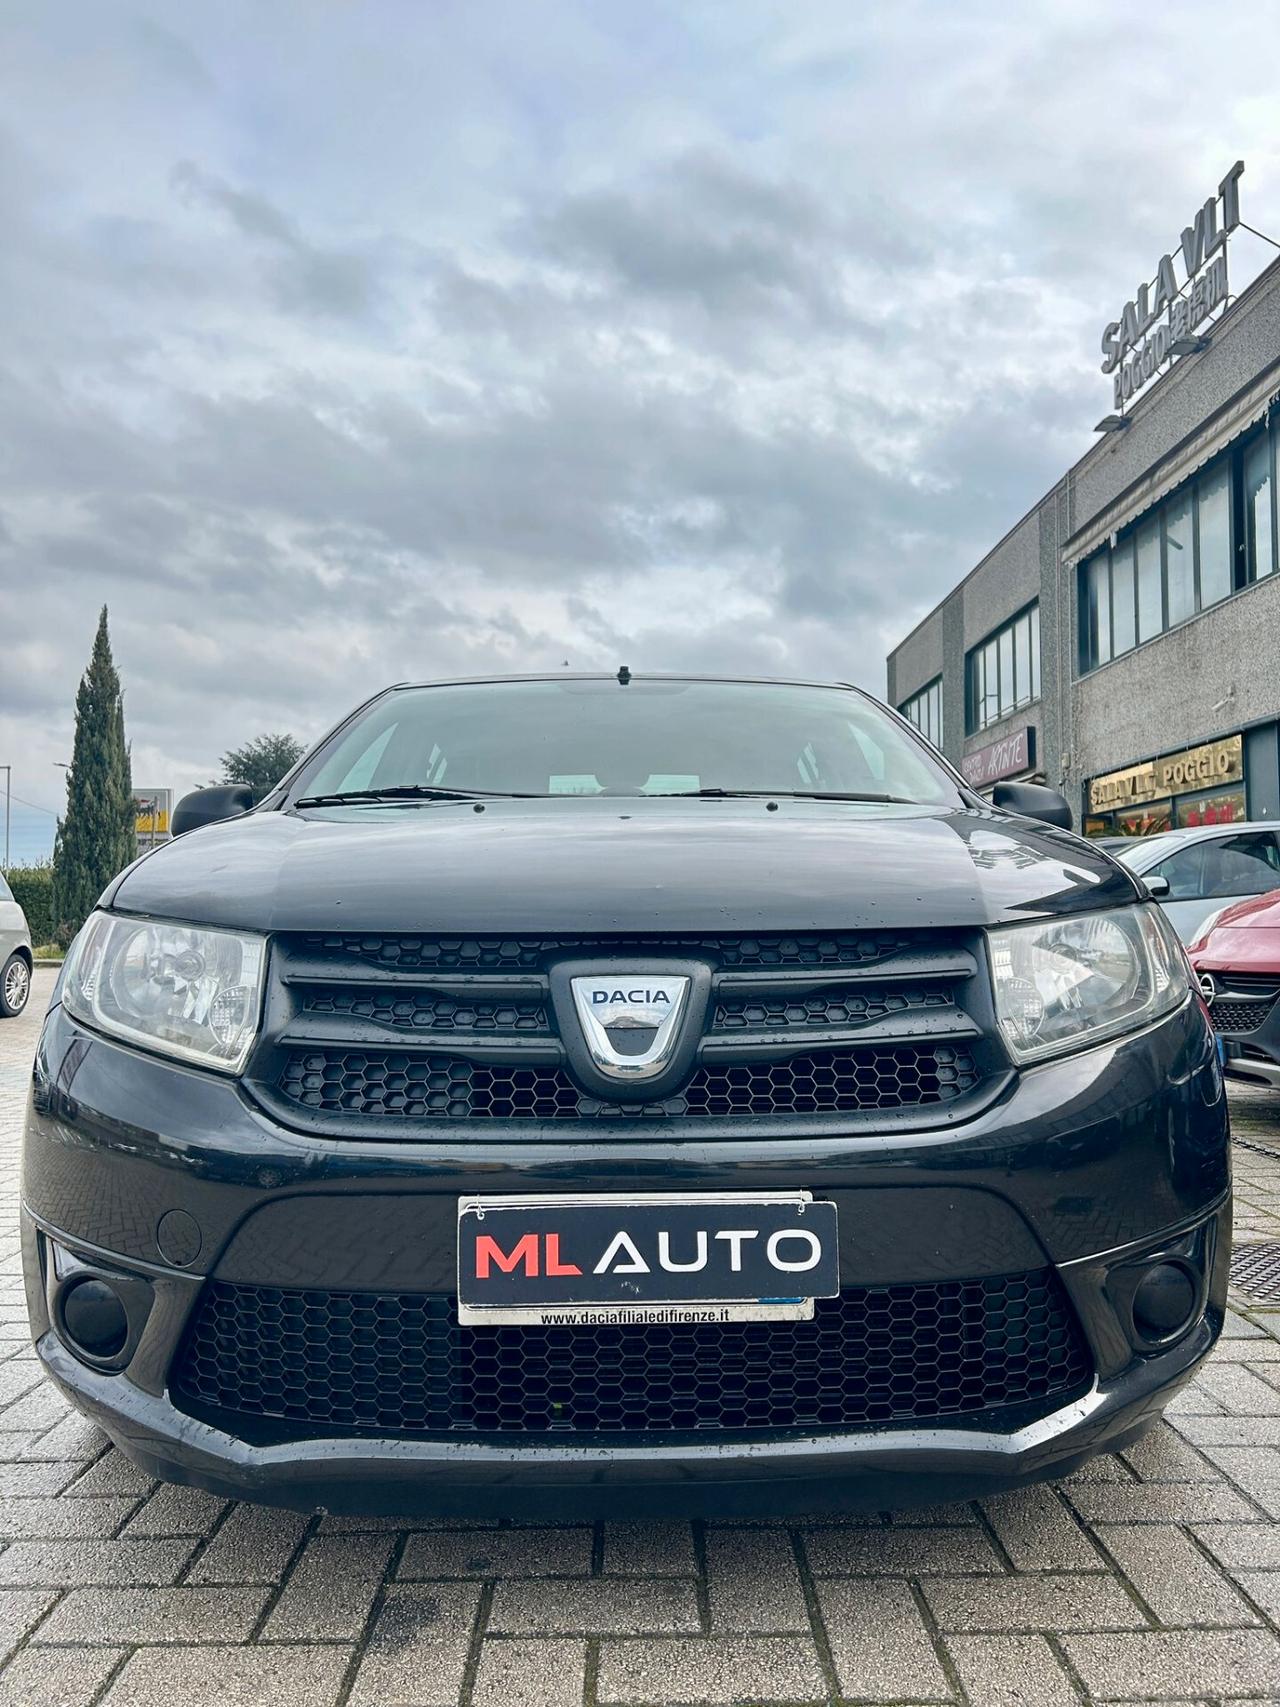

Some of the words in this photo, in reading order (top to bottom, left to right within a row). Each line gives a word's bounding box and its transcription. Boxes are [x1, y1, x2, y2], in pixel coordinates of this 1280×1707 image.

[1101, 254, 1178, 374] SALA
[1180, 160, 1244, 278] VLT
[1114, 324, 1172, 410] POGGIO
[1162, 750, 1229, 787] POGGIO
[592, 990, 671, 1004] DACIA
[475, 1233, 583, 1279] ML
[592, 1228, 822, 1274] AUTO
[540, 1308, 731, 1325] www.daciafilialedifirenze.it
